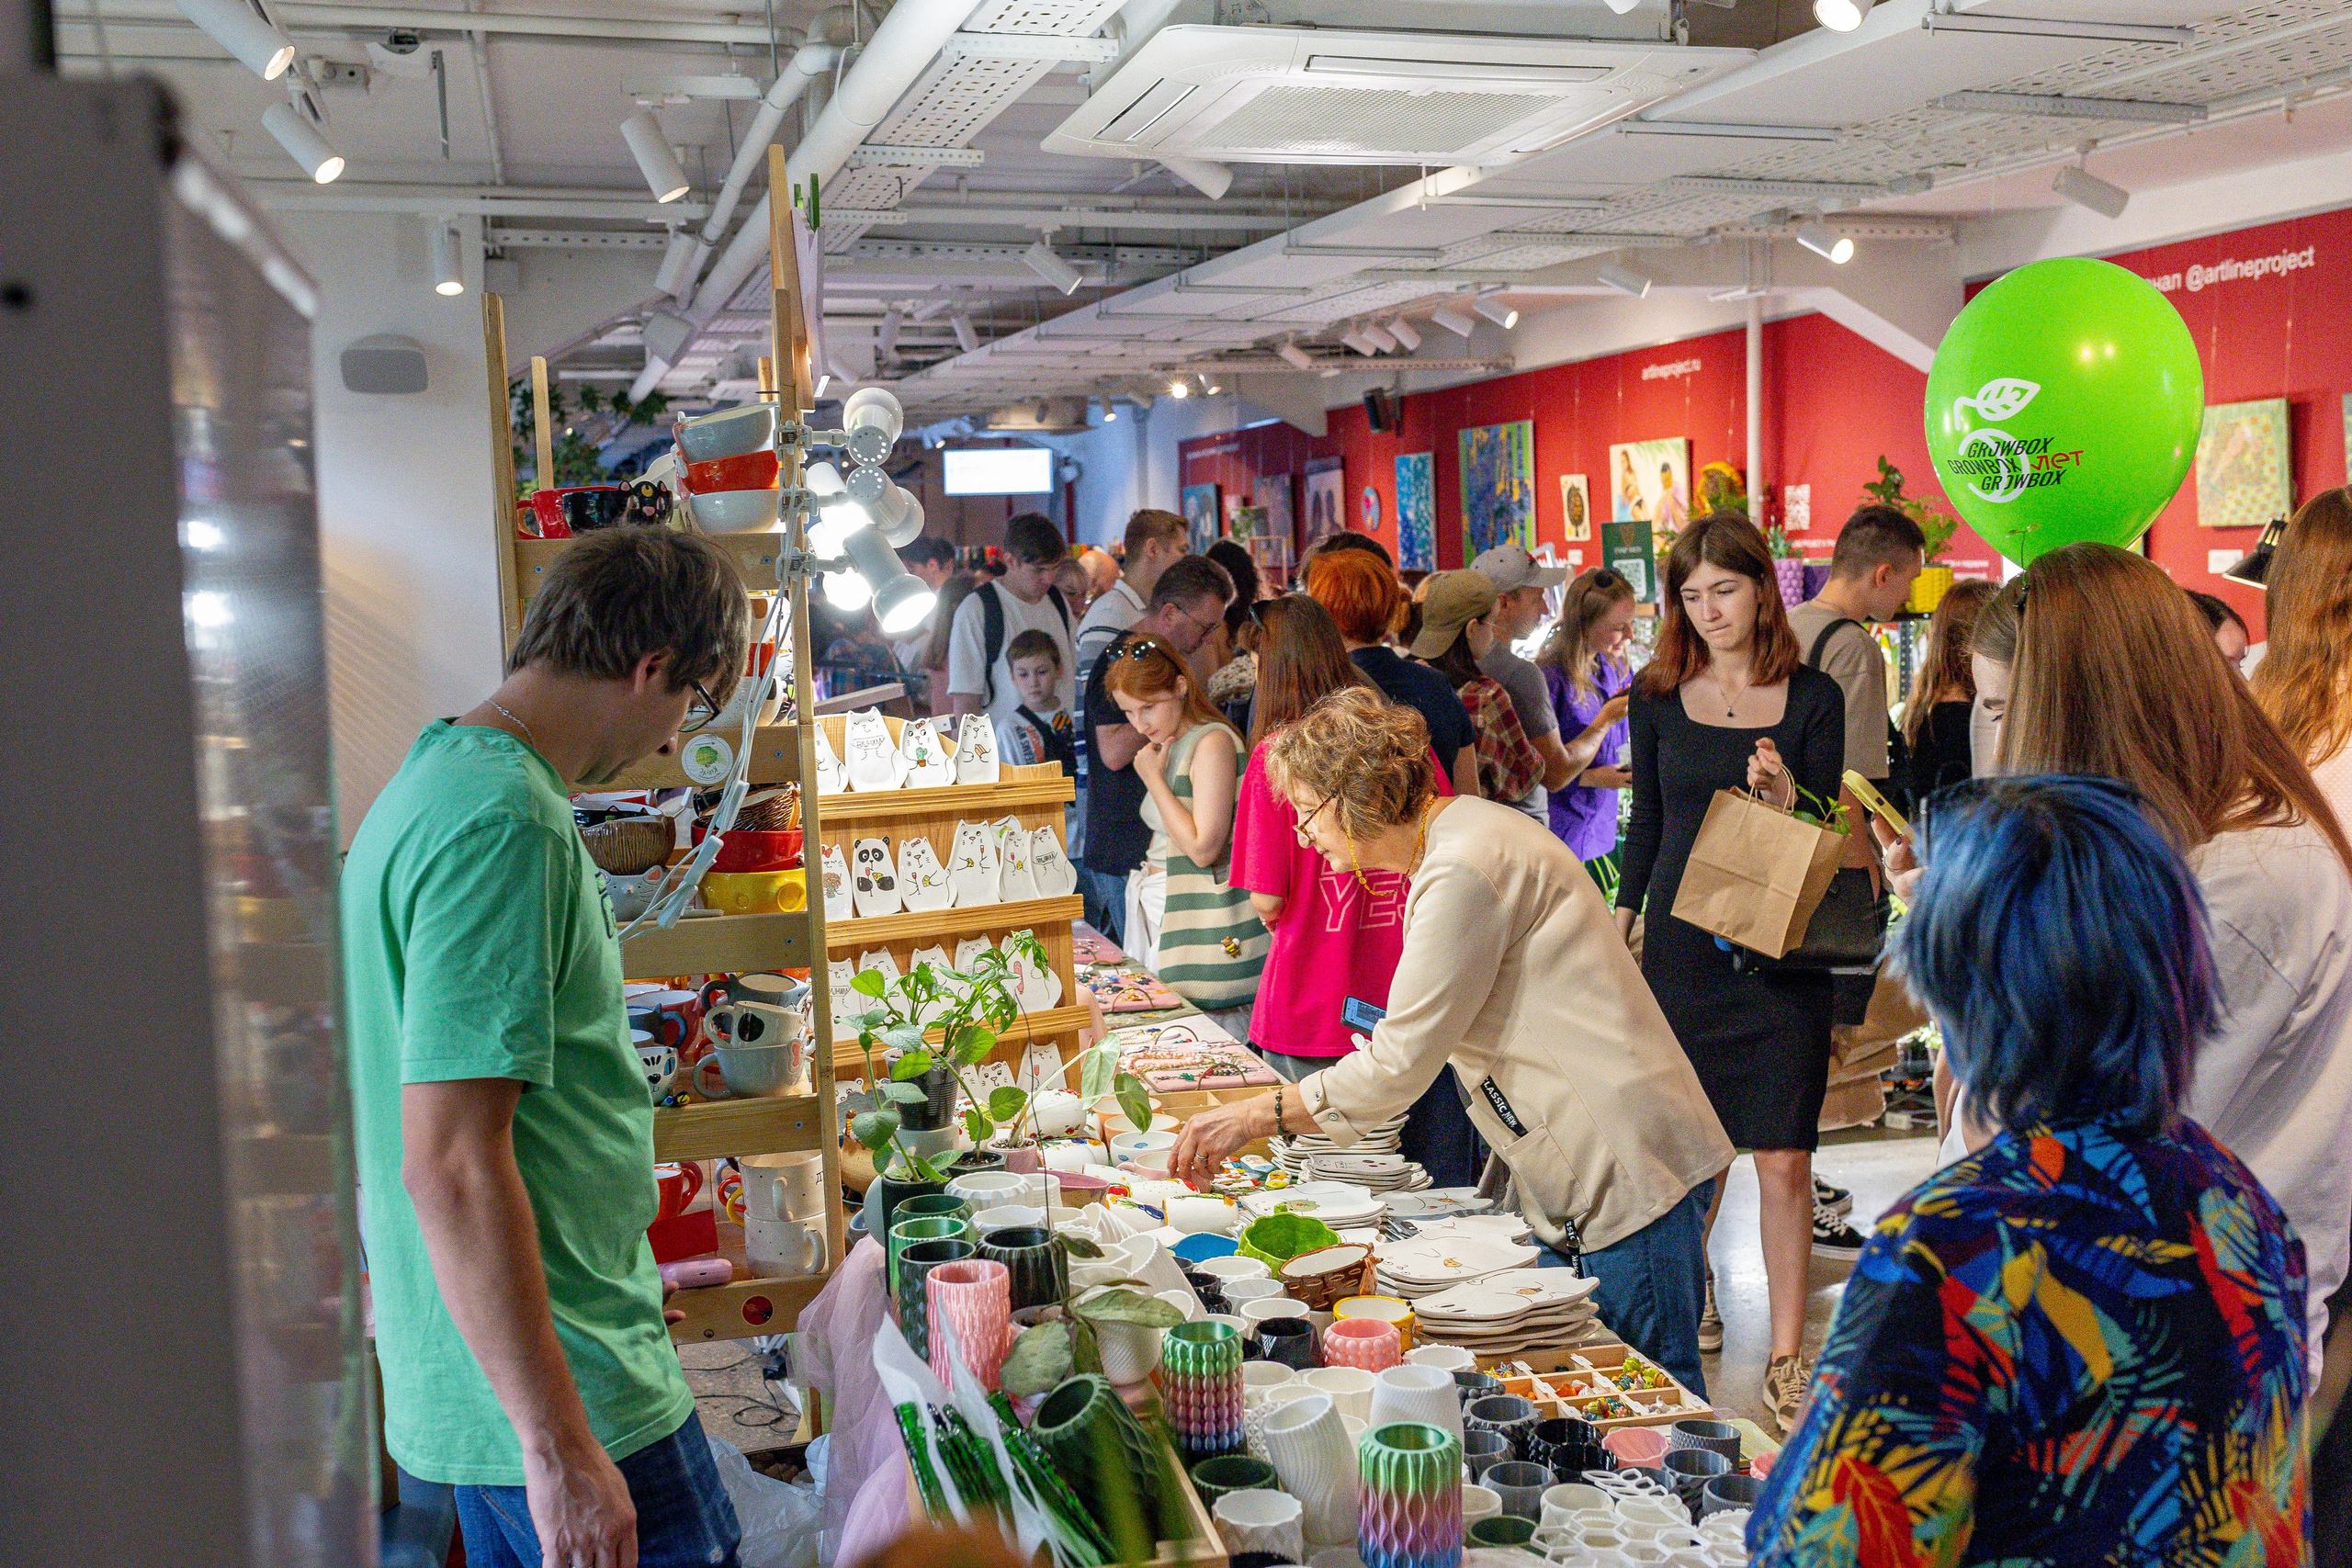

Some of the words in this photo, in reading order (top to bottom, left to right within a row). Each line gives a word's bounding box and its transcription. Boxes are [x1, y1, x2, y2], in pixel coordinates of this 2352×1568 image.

[2186, 245, 2315, 292] @artlineproject
[1967, 437, 2055, 457] GROWBOX
[2030, 450, 2085, 471] лет
[1947, 457, 2023, 475] GROWBOX
[1318, 870, 1409, 932] YE
[1483, 1077, 1508, 1113] LASSIC
